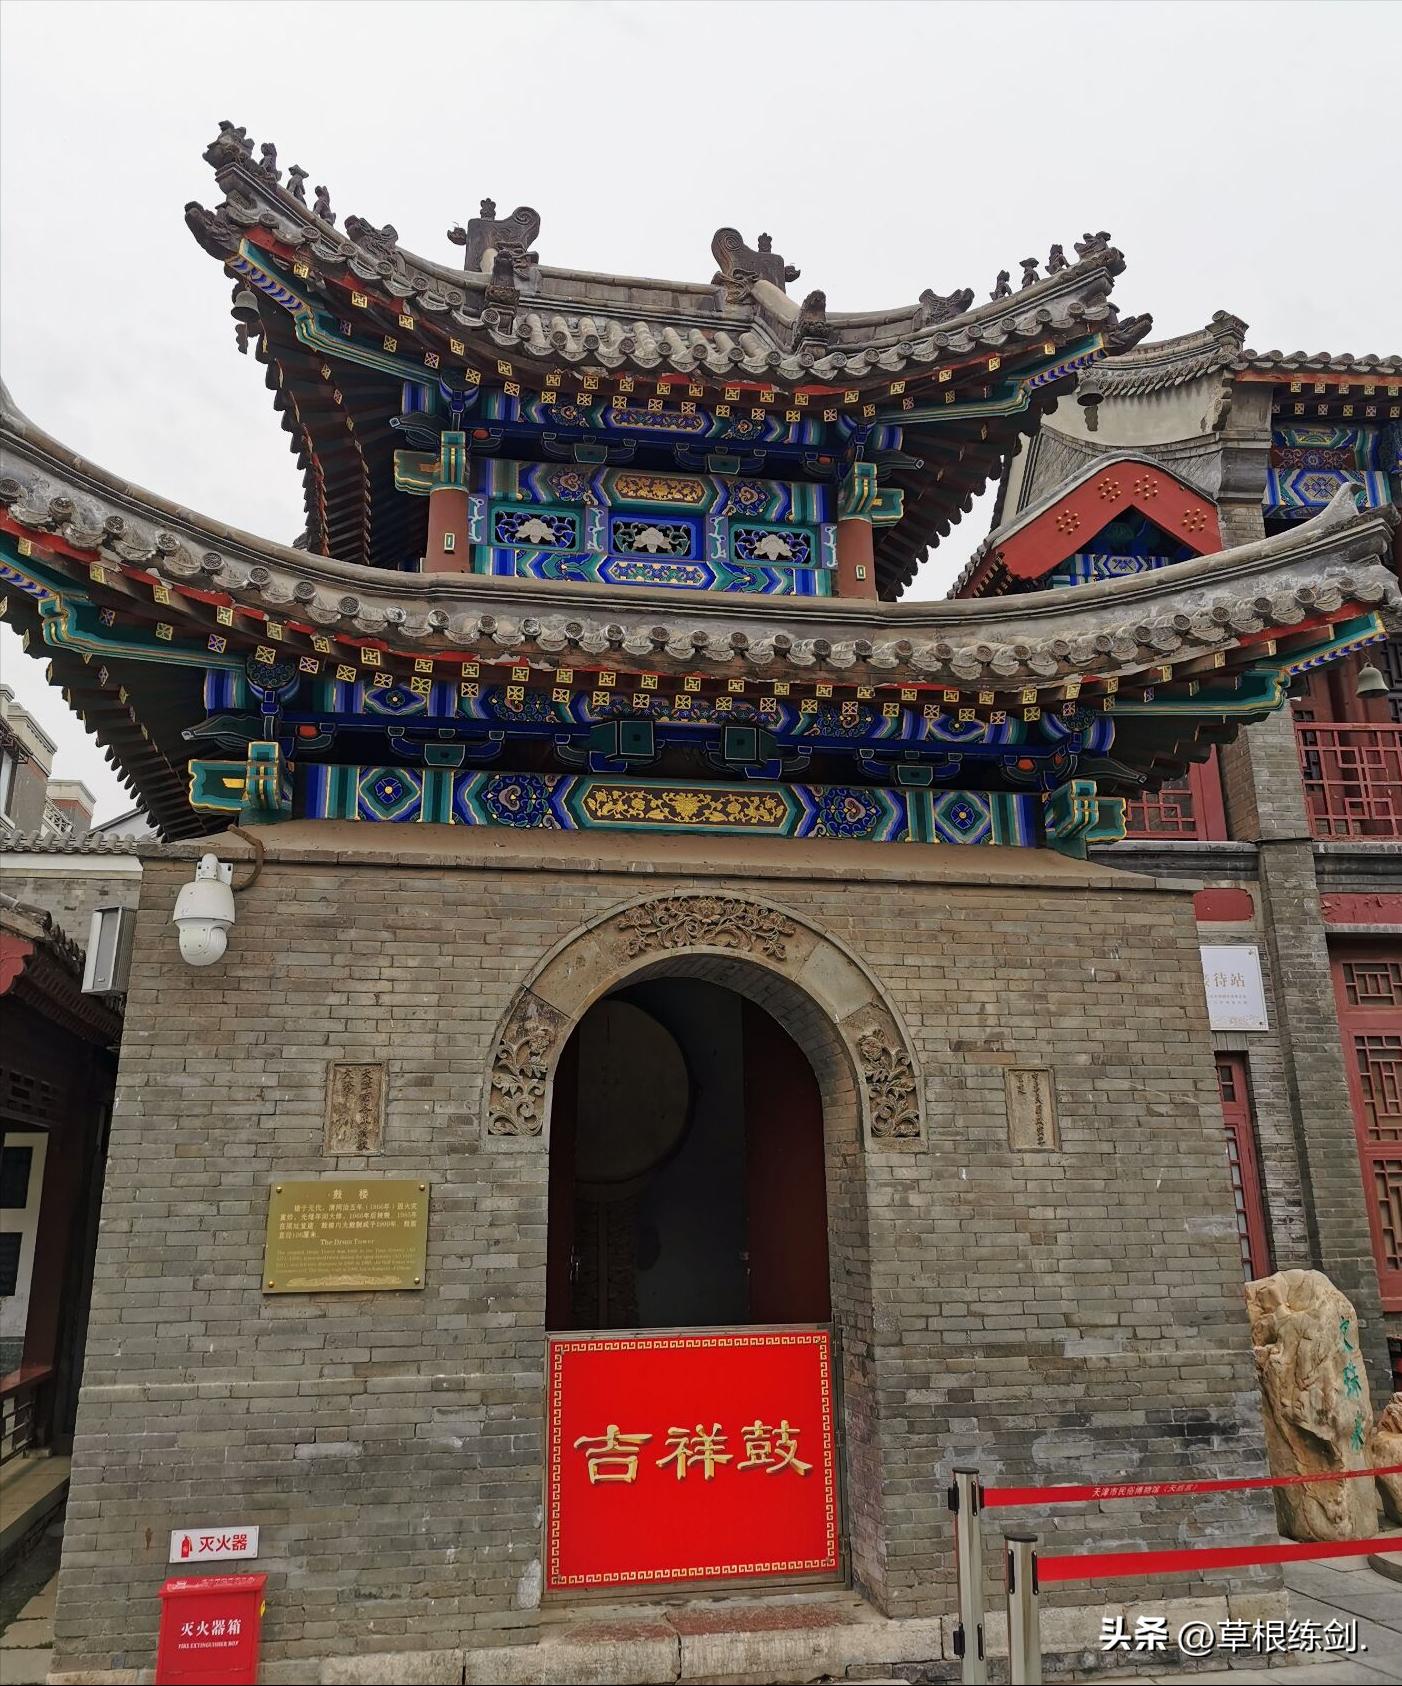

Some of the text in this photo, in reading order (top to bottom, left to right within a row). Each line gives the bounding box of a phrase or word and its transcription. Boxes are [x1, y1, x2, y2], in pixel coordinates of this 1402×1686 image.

[1205, 972, 1245, 987] 待站
[573, 1420, 814, 1485] 吉祥鼓
[199, 1534, 248, 1552] 灭火器
[181, 1618, 242, 1637] 灭火器箱
